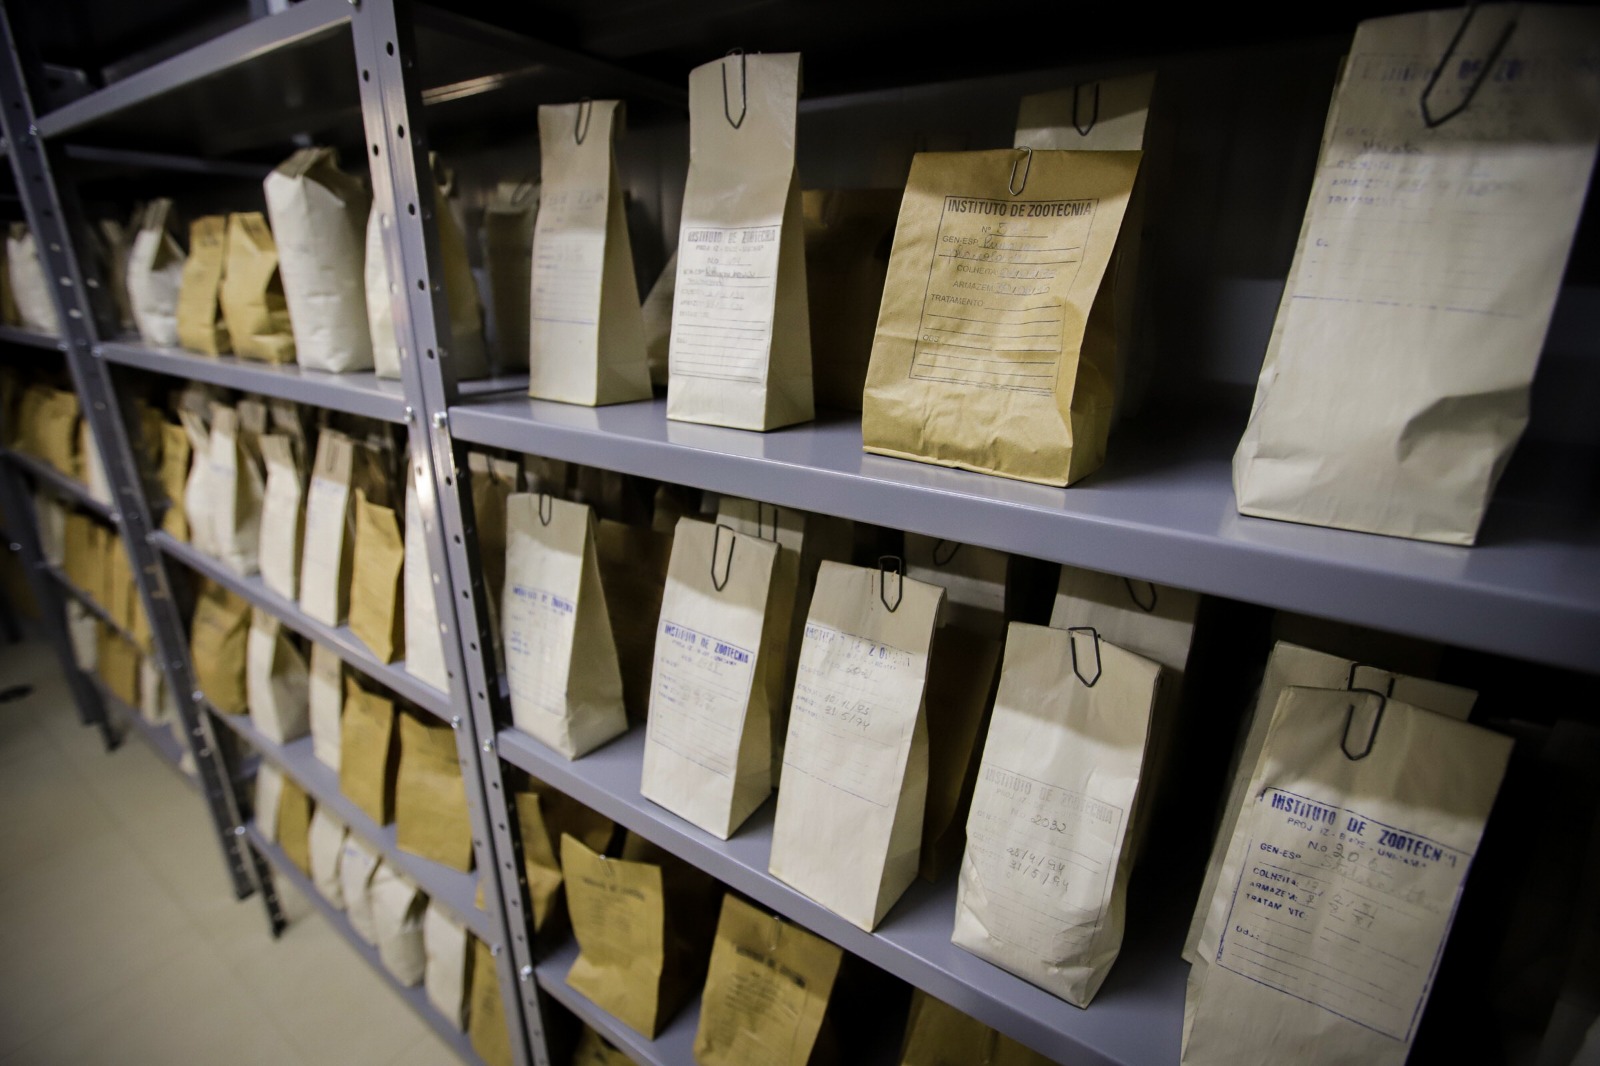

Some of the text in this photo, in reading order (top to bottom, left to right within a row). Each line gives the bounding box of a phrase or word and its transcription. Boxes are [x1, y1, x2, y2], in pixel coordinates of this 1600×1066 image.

[948, 199, 1092, 218] INSTITUTO DE ZOOTECNIA
[930, 293, 984, 307] TRATAMENTO
[713, 642, 750, 664] ZOOTECNIA
[985, 767, 1032, 795] INSTITUTO
[1271, 793, 1337, 826] INSTITUTO
[1346, 816, 1366, 837] DE
